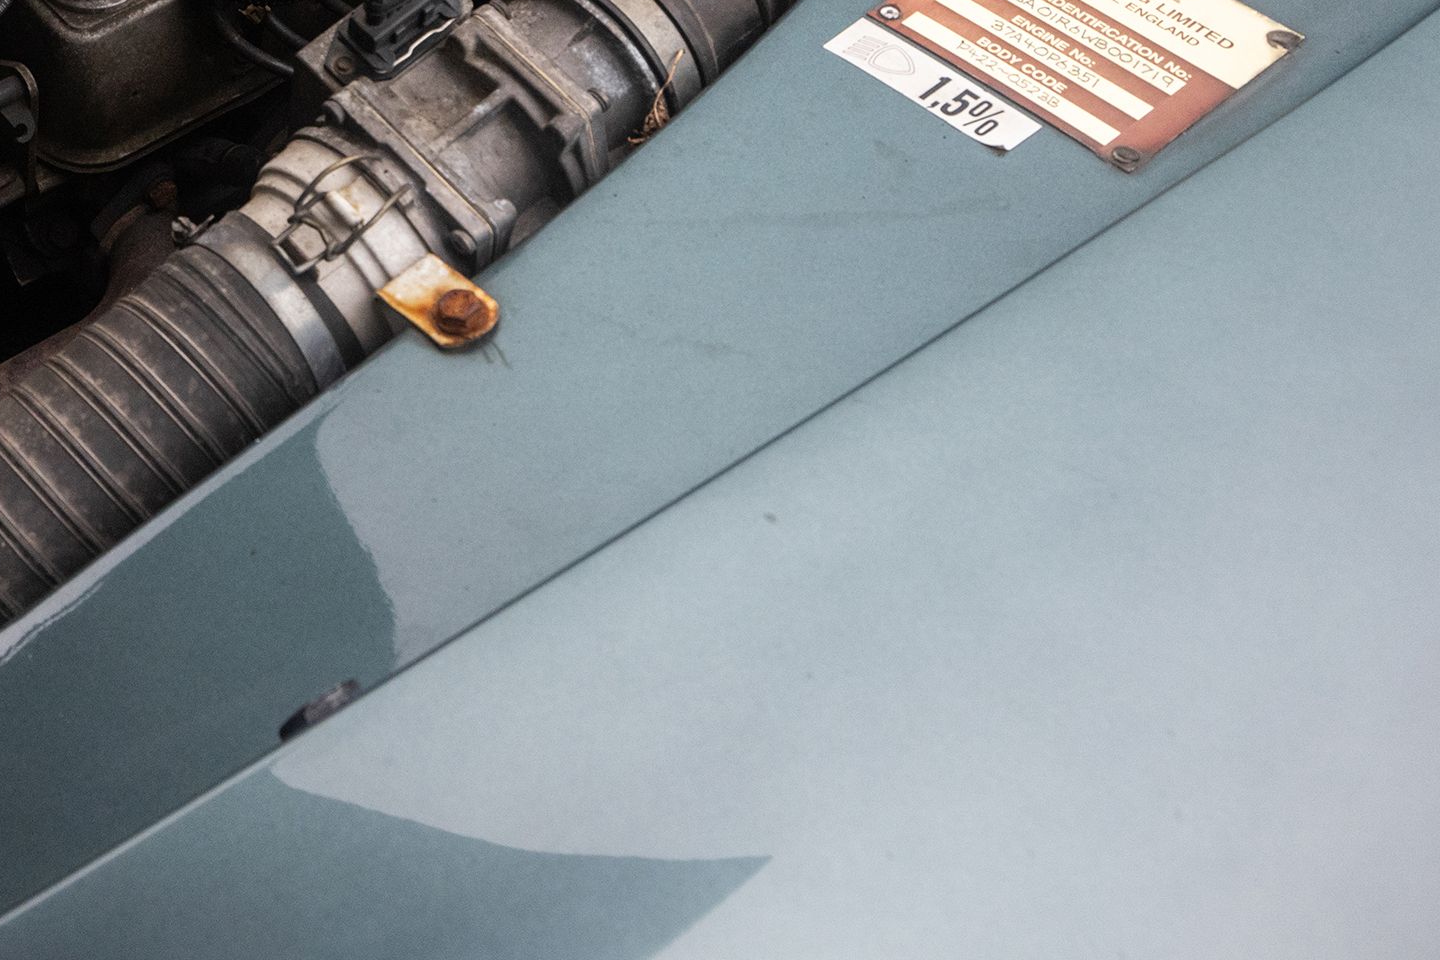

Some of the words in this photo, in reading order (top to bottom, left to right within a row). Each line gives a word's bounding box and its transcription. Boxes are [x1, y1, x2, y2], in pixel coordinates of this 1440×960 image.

[1012, 15, 1070, 50] ENGINE
[1069, 48, 1097, 67] No:
[1126, 2, 1201, 47] ENGLAND
[1157, 2, 1235, 49] LIMITED
[977, 37, 1021, 65] BODY
[1019, 63, 1067, 93] CODE
[1163, 61, 1192, 81] No:
